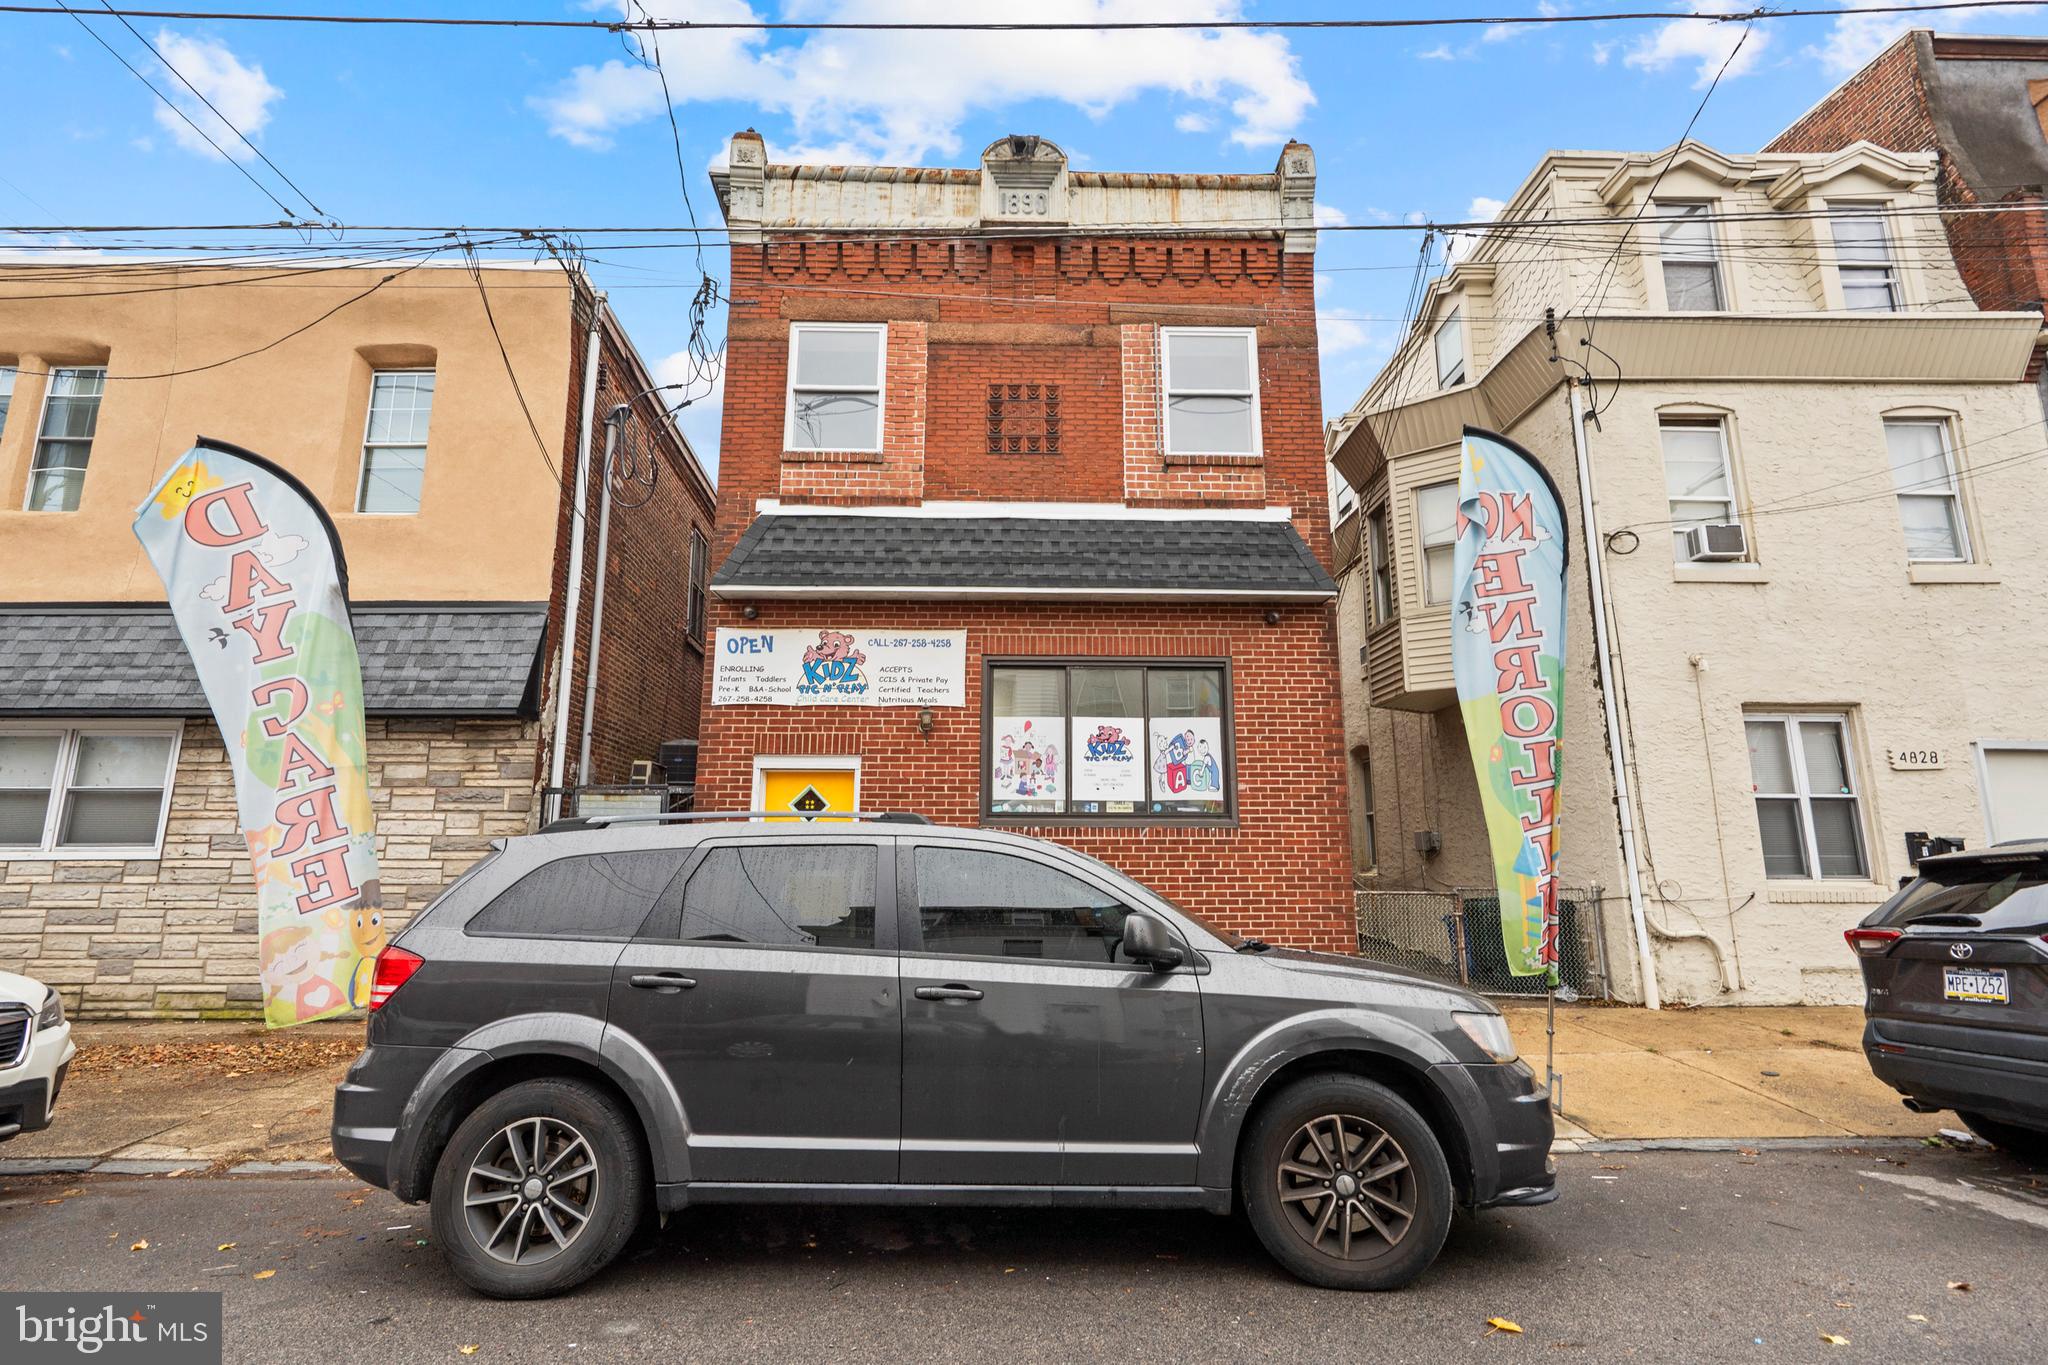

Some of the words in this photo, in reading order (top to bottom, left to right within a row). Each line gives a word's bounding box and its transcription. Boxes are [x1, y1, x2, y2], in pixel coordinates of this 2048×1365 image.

[1000, 192, 1047, 215] 1890
[727, 635, 774, 654] OPEN
[867, 638, 952, 648] CALL-267-258-4258
[719, 675, 746, 683] Infants
[908, 676, 933, 684] Private
[935, 676, 949, 685] Pay
[718, 685, 740, 693] Pre-K
[749, 685, 792, 693] B&A-School
[718, 695, 773, 703] 267-258-4258
[797, 695, 817, 703] Child
[820, 695, 839, 703] Care
[841, 695, 870, 703] Center
[1899, 750, 1938, 764] 4828
[1174, 770, 1185, 789] A
